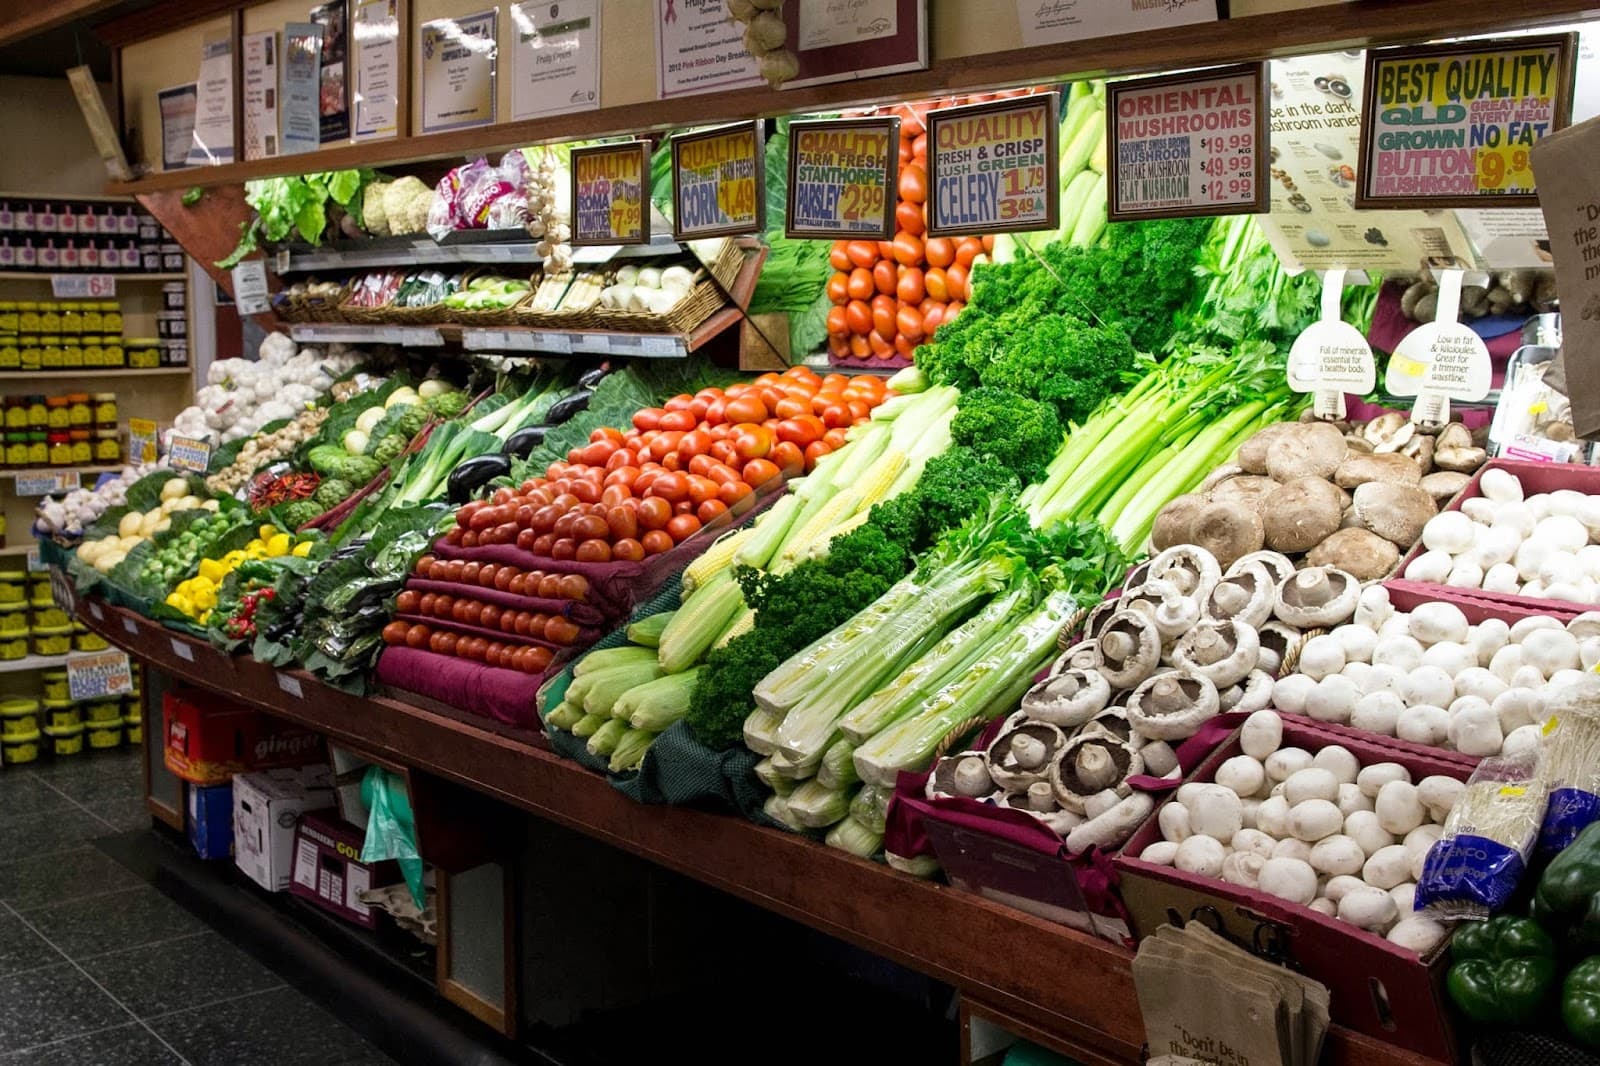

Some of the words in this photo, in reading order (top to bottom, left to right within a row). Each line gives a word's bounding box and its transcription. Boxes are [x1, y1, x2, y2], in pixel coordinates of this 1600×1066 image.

[668, 63, 682, 73] 2012
[682, 61, 695, 69] Pink
[695, 57, 716, 67] Ribbon
[716, 54, 727, 64] Day
[727, 50, 753, 61] Breakfa
[1380, 62, 1440, 105] BEST
[1445, 53, 1555, 103] QUALITY
[1119, 84, 1252, 118] ORIENTAL
[1286, 104, 1299, 117] in
[1301, 102, 1323, 116] the
[1325, 99, 1356, 114] dark
[1470, 99, 1515, 112] GREAT
[1520, 97, 1551, 109] FOR
[1119, 108, 1252, 140] MUSHROOMS
[1381, 104, 1467, 126] QLD
[1469, 110, 1512, 123] EVERY
[1514, 109, 1550, 122] MEAL
[937, 108, 1045, 150] QUALITY
[1378, 128, 1465, 150] GROWN
[1469, 124, 1501, 148] NO
[1508, 122, 1549, 147] FAT
[680, 132, 754, 170] QUALITY
[800, 132, 888, 154] QUALITY
[937, 149, 972, 165] FRESH
[977, 146, 988, 160] &
[994, 138, 1044, 157] CRISP
[1148, 138, 1167, 150] SWISS
[1200, 134, 1252, 154] $19.99
[799, 153, 834, 166] FARM
[837, 153, 887, 168] FRESH
[937, 164, 971, 177] LUSH
[977, 153, 1045, 172] GREEN
[1120, 147, 1190, 163] MUSHROOM
[1376, 149, 1477, 177] BUTTON
[578, 151, 641, 183] QUALITY
[799, 166, 885, 186] STANTHORPE
[1148, 159, 1190, 178] MUSHROOM
[1200, 156, 1251, 177] $49.99
[1479, 150, 1533, 188] $9.9
[1120, 180, 1139, 201] FLAT
[1142, 176, 1189, 200] MUSHROOM
[1201, 179, 1251, 200] $12.99
[1375, 174, 1479, 195] MUSHROOM
[577, 193, 609, 211] ROMA
[681, 181, 720, 229] CORN
[797, 183, 841, 220] PARSLEY
[939, 171, 999, 226] CELERY
[1573, 226, 1598, 246] the
[1430, 344, 1437, 352] &
[1437, 335, 1453, 344] Low
[1454, 336, 1460, 344] in
[1462, 335, 1473, 344] fat
[1435, 354, 1457, 363] Great
[1457, 354, 1469, 363] for
[336, 841, 362, 862] GOL
[1169, 1040, 1189, 1058] the
[1219, 1040, 1235, 1060] be
